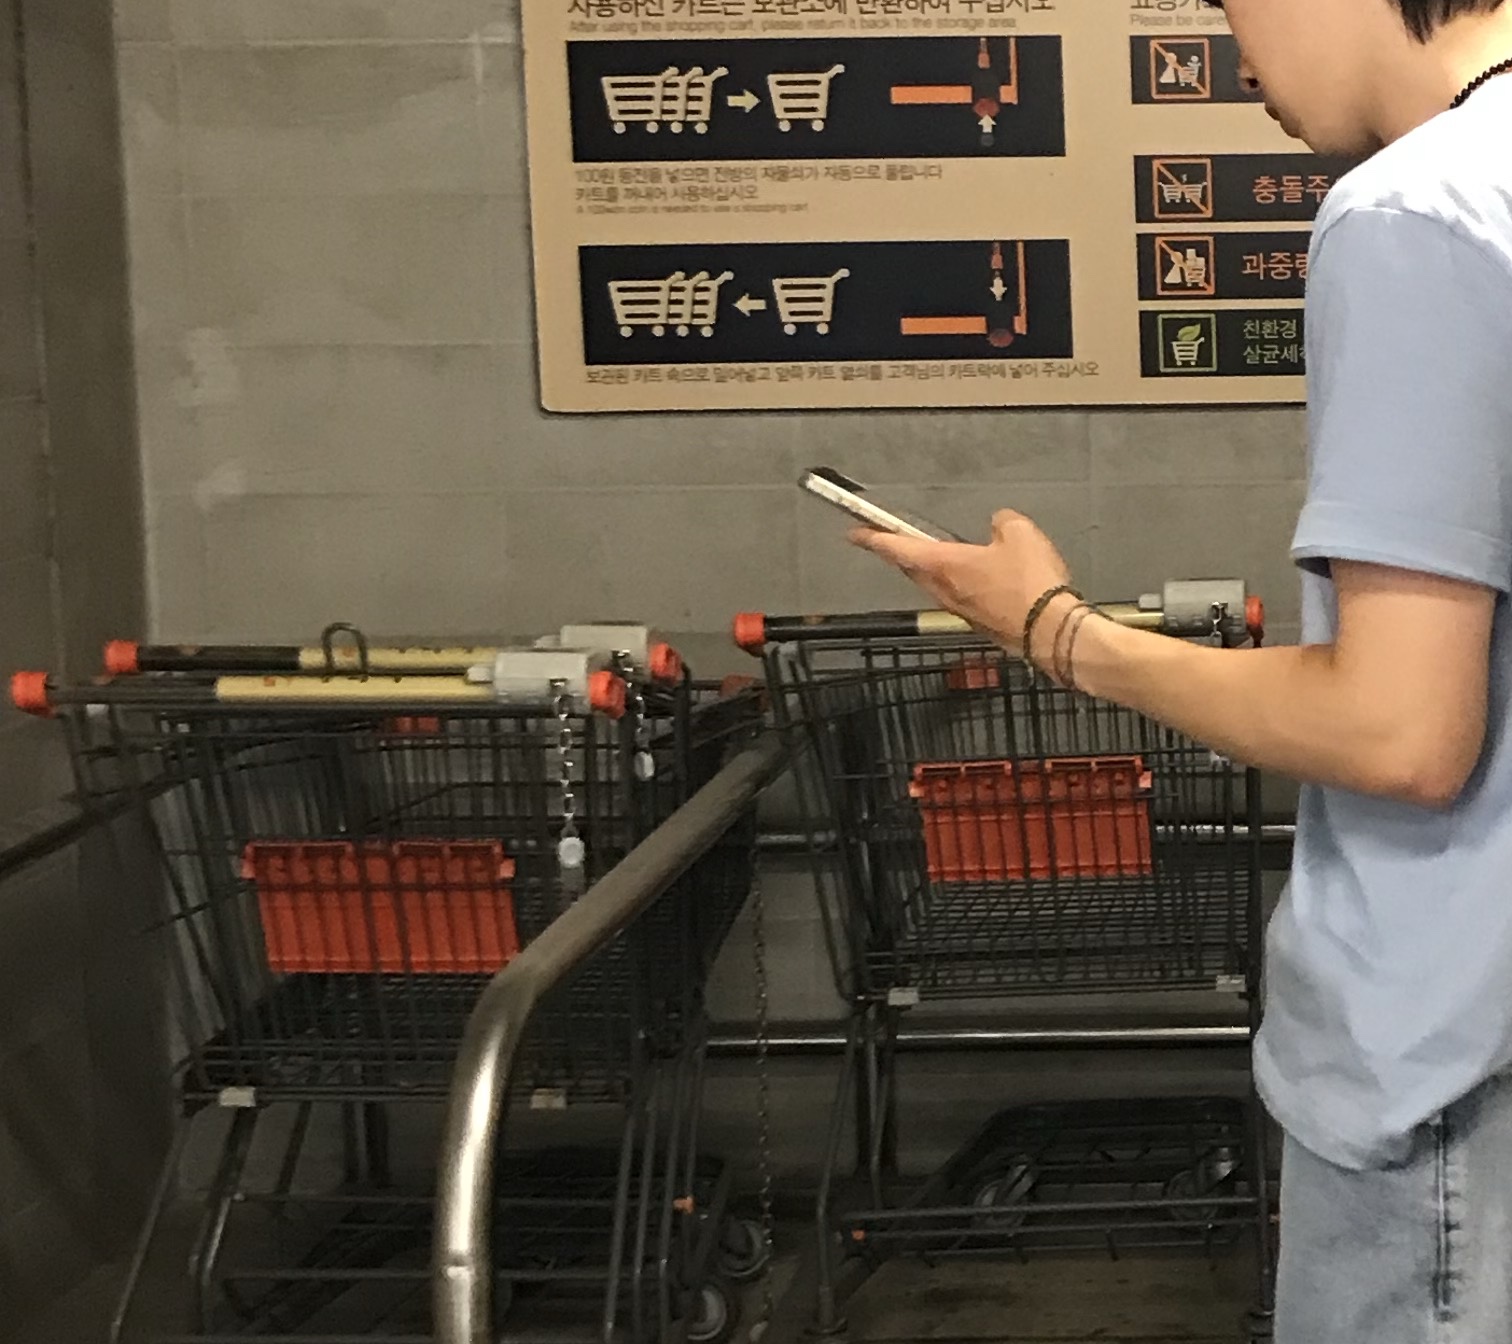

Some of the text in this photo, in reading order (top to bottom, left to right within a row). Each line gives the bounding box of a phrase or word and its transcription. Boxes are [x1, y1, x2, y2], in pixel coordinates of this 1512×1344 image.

[1251, 174, 1331, 205] 충돌주
[1243, 318, 1297, 340] 친환경
[1243, 343, 1306, 365] 살균세
